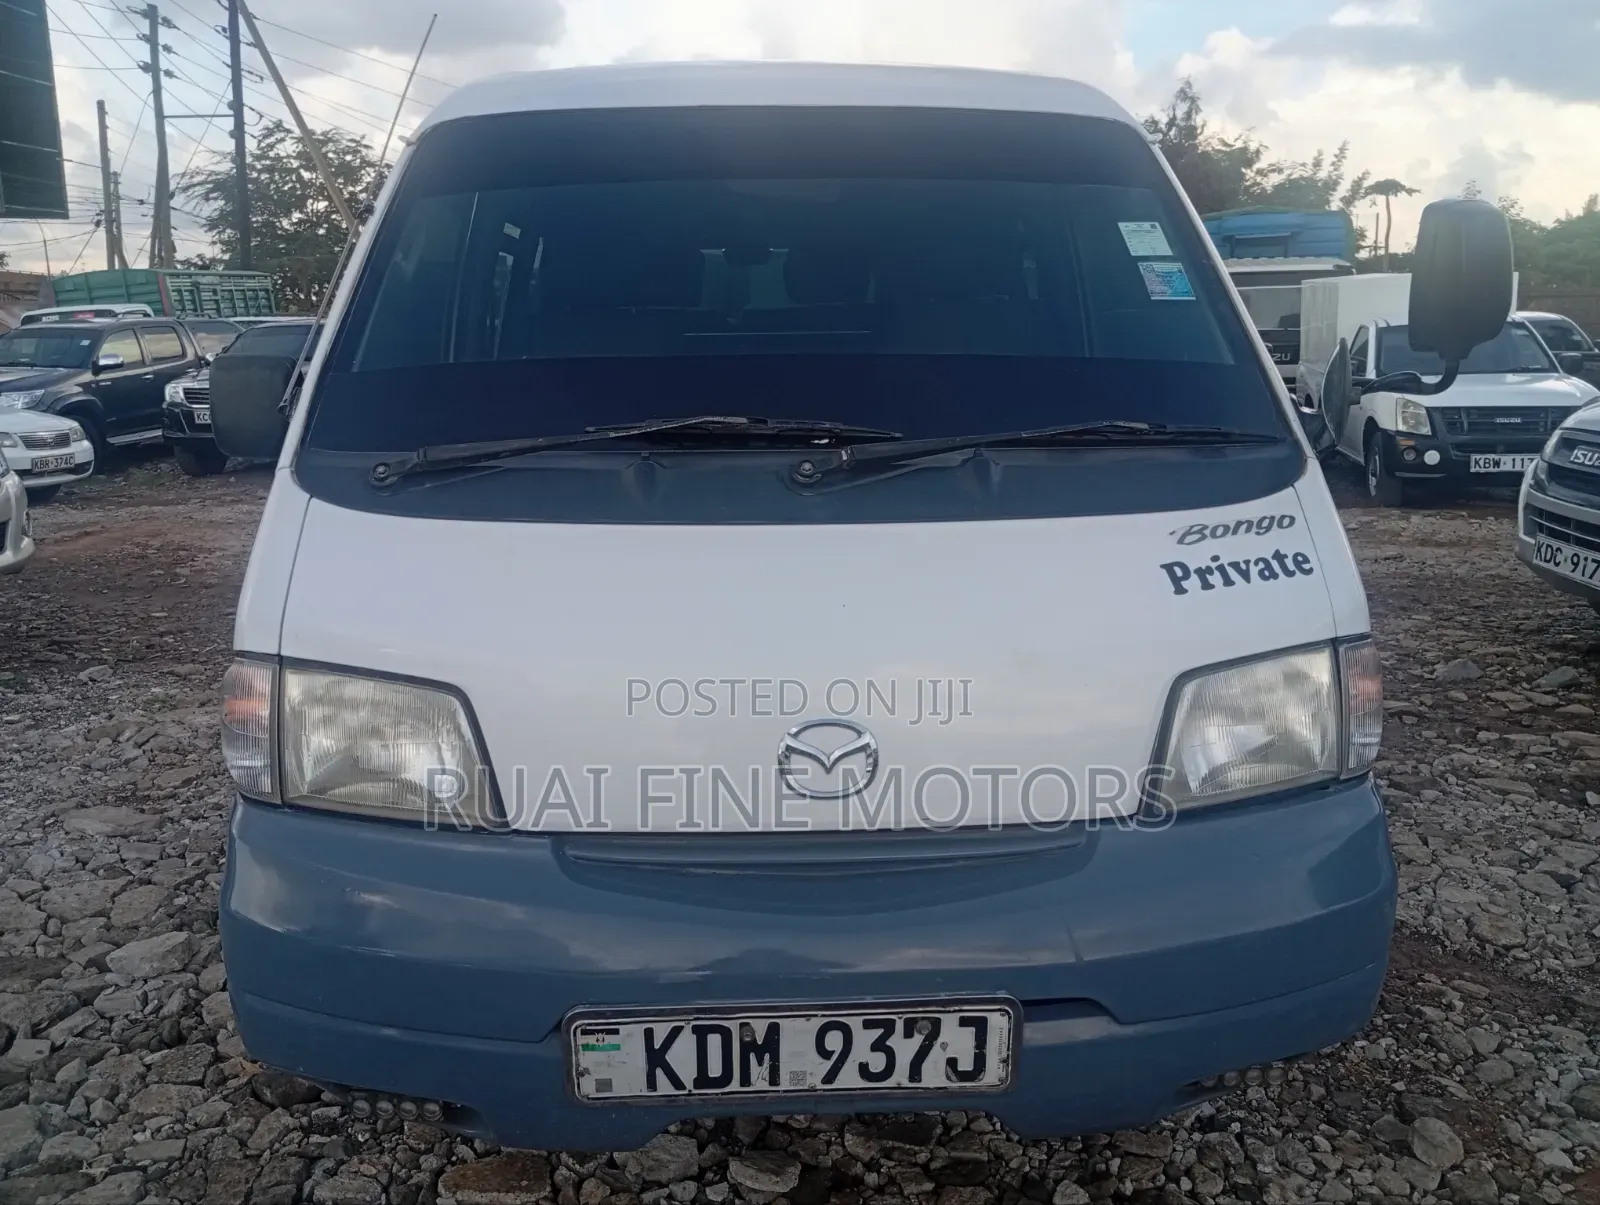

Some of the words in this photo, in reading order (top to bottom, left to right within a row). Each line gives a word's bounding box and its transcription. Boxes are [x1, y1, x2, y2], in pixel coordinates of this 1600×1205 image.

[195, 412, 211, 422] KC
[1473, 457, 1502, 470] KBW
[1169, 514, 1297, 546] Bongo
[1535, 540, 1563, 568] KDC
[1159, 548, 1315, 596] Private
[644, 1021, 781, 1092] KDM
[814, 1015, 989, 1085] 937J
